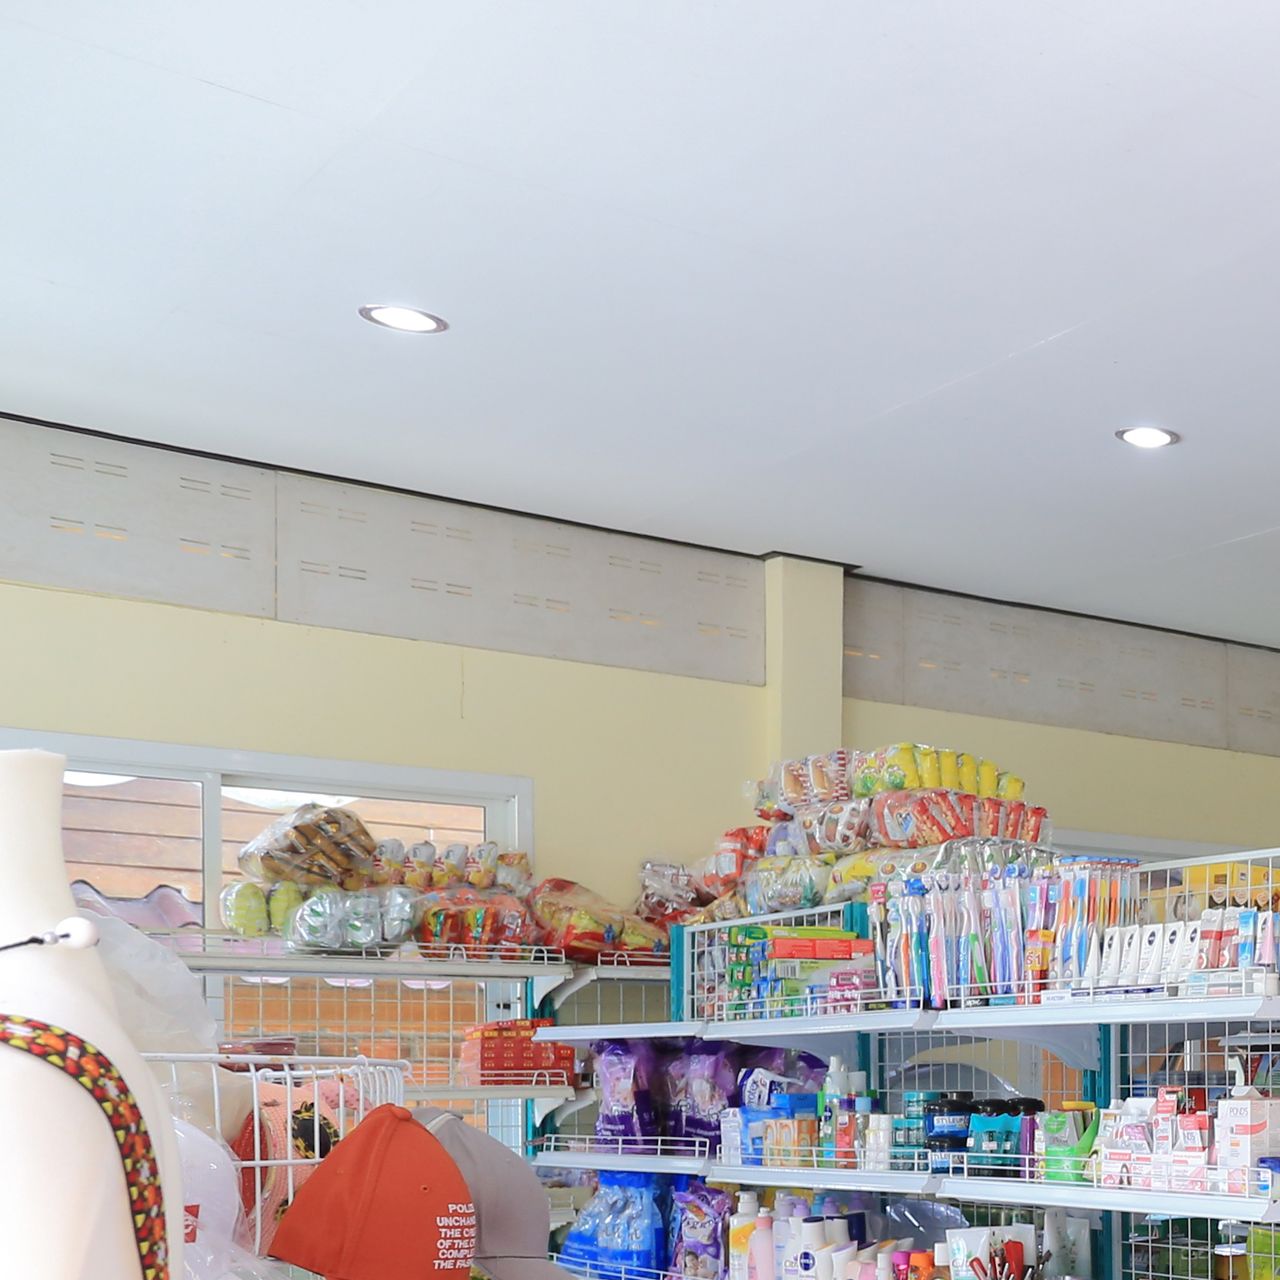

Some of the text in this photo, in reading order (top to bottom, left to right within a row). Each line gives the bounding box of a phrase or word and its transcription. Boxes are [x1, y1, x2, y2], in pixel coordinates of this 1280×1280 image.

[439, 1228, 462, 1238] THE
[437, 1239, 452, 1249] OF
[433, 1260, 455, 1269] THE
